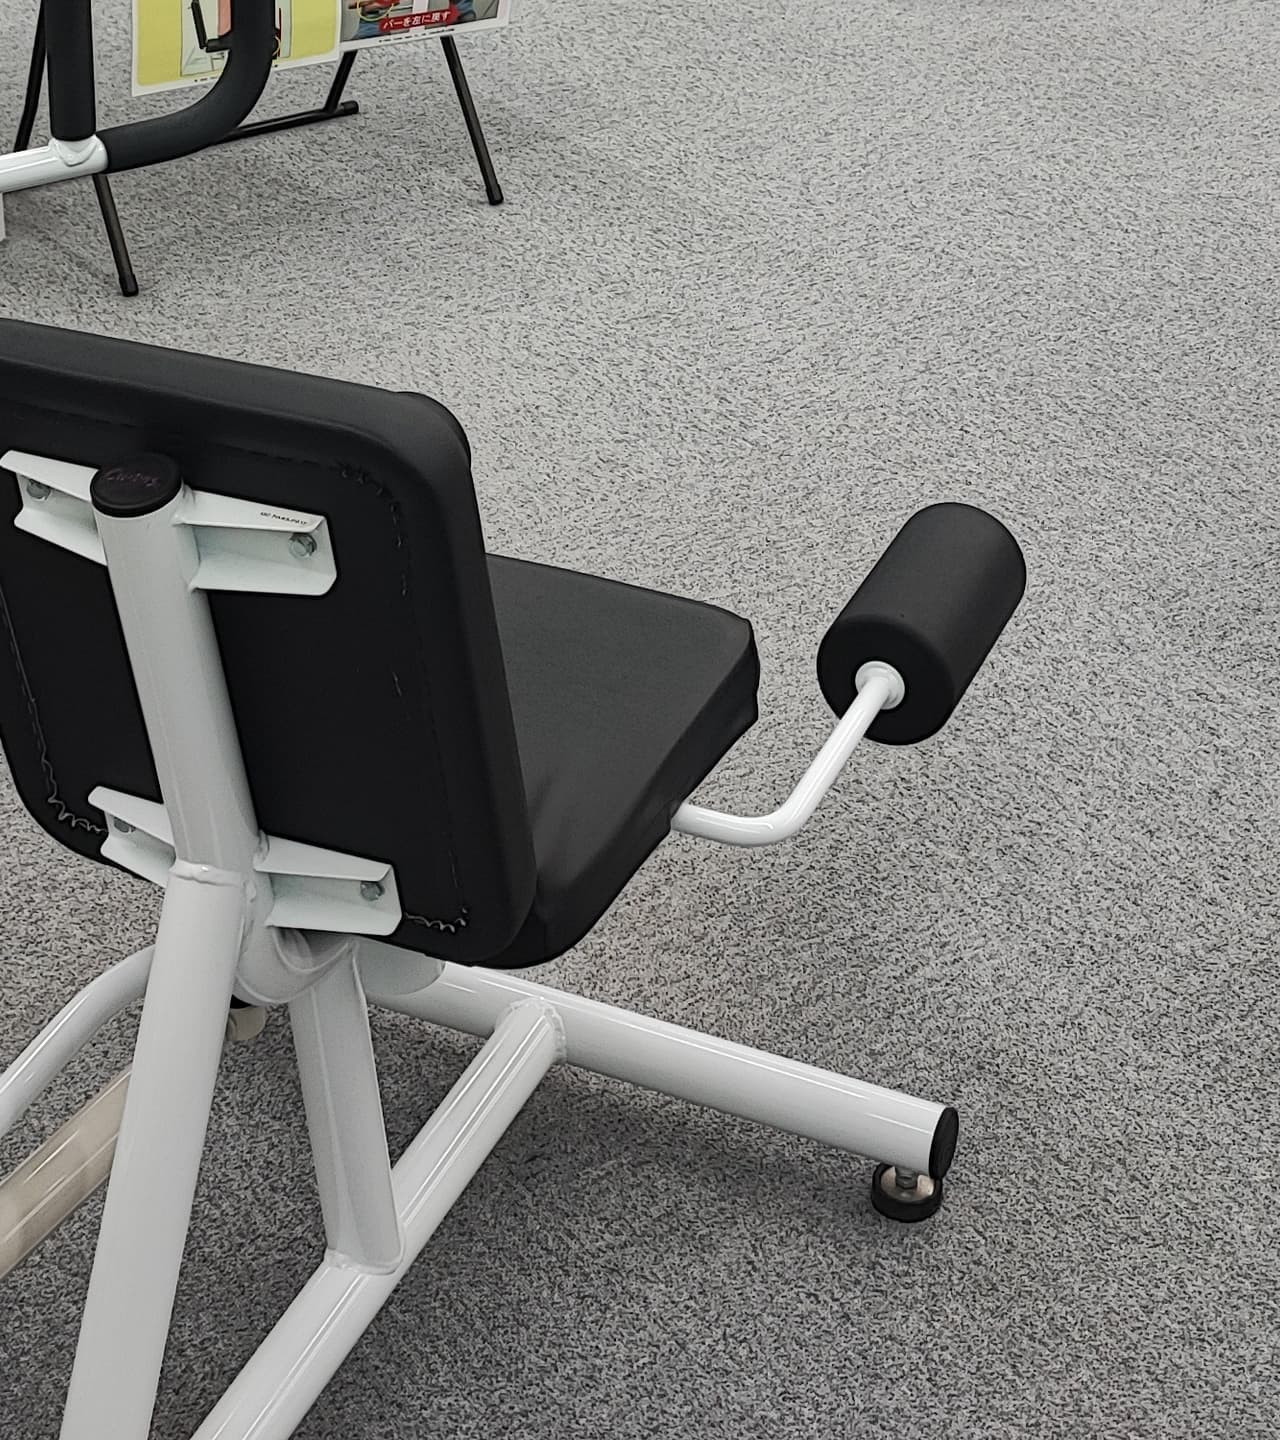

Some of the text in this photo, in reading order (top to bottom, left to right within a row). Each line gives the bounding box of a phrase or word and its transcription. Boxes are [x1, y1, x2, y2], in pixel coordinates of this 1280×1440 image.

[383, 11, 450, 29] バーを左に戻す
